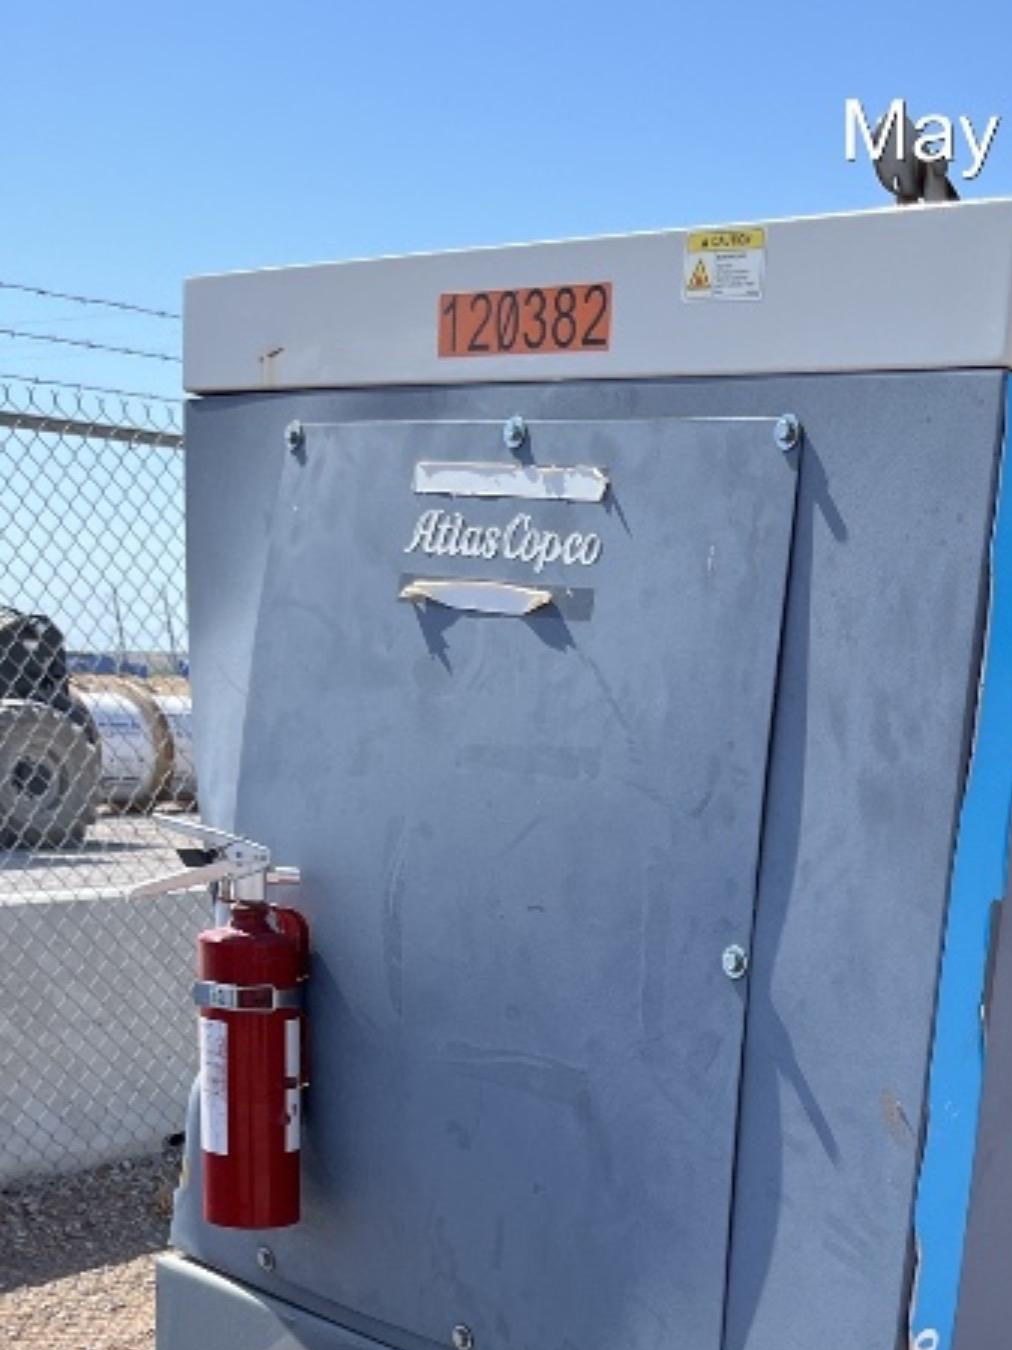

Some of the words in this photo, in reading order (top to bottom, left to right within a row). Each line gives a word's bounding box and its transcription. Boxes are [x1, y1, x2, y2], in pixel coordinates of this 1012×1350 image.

[442, 284, 608, 353] 120382
[403, 508, 501, 560] Atlas
[502, 512, 602, 575] Copco
